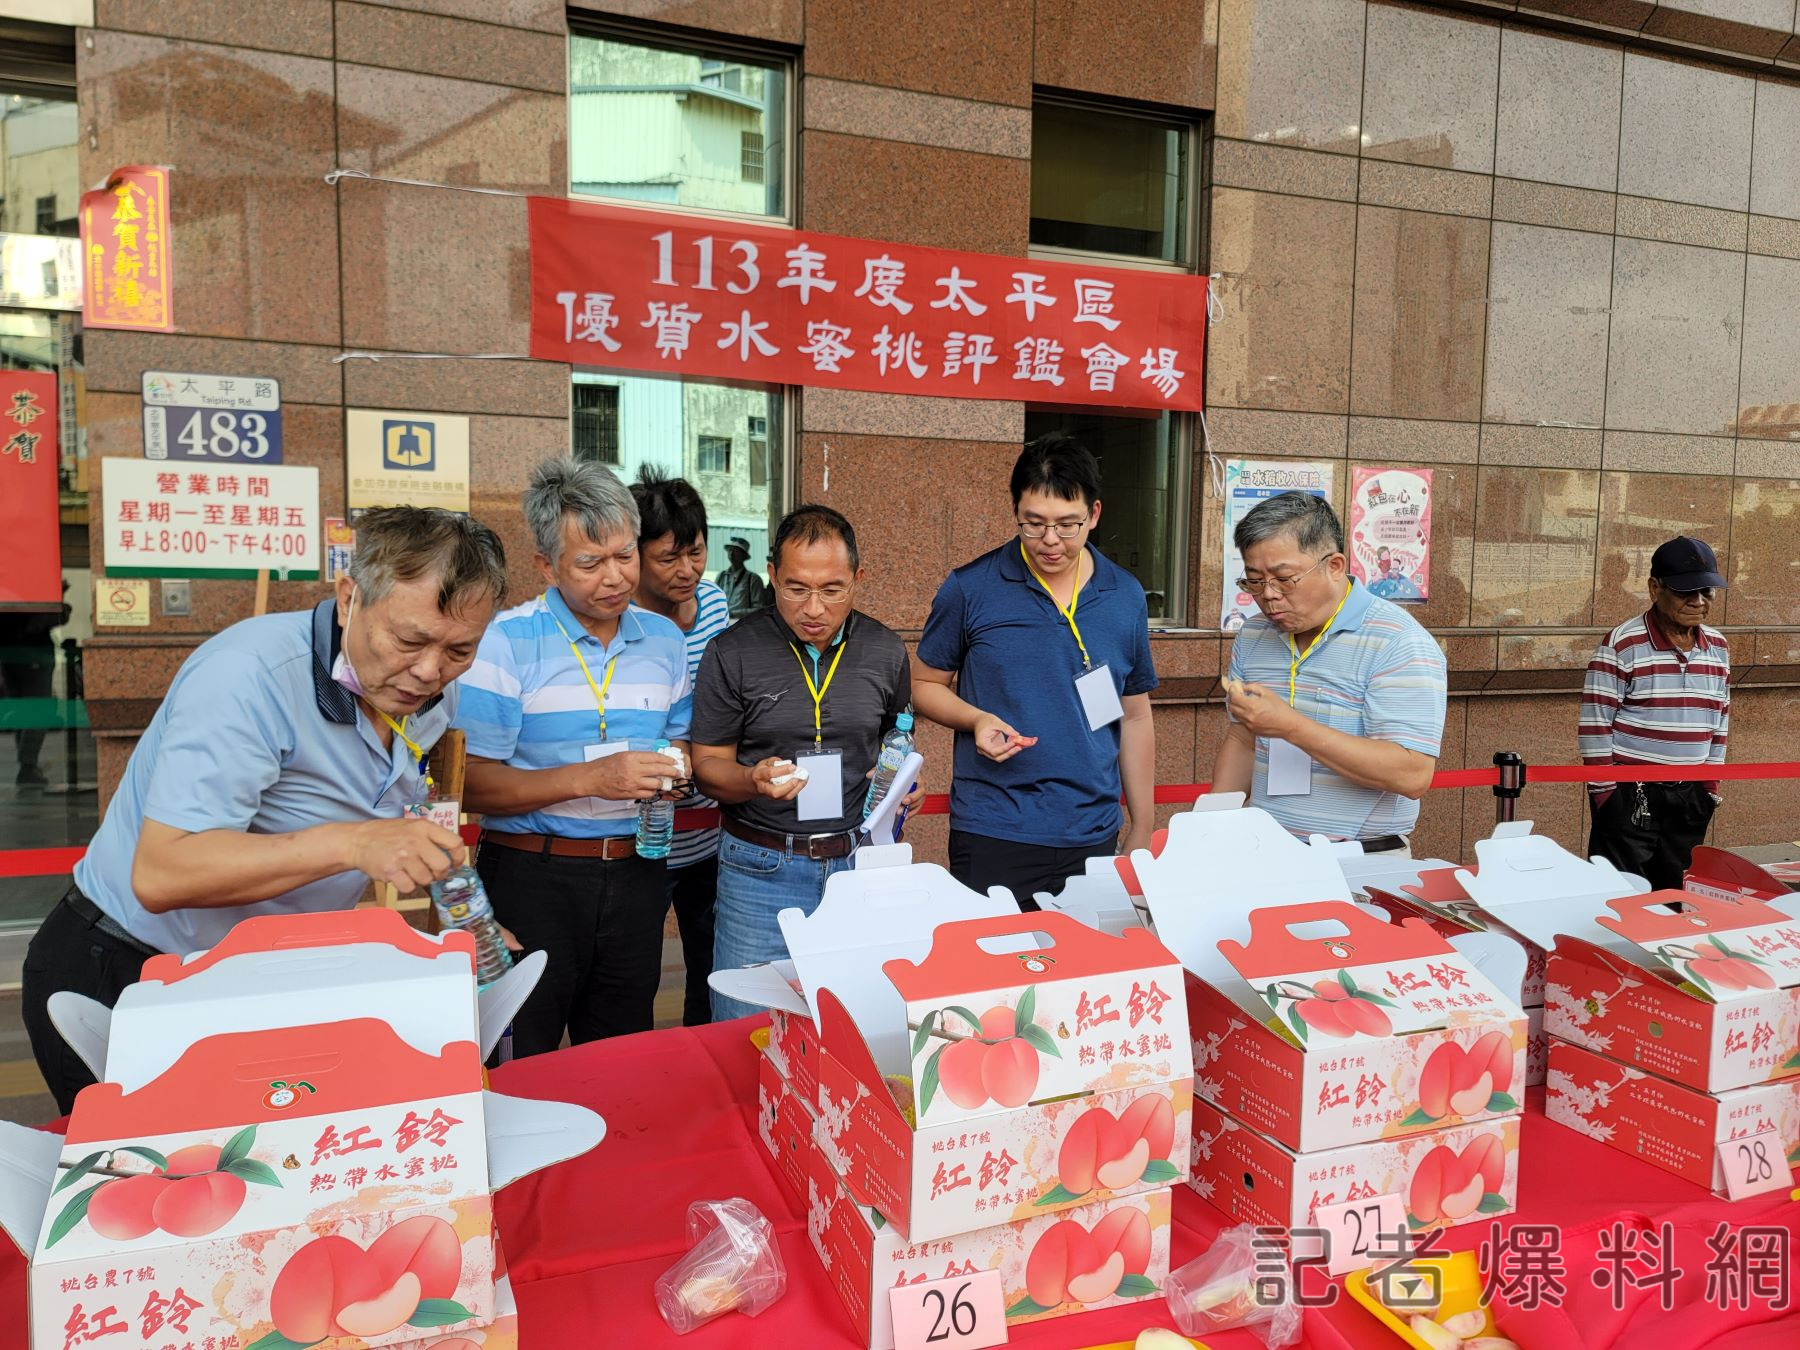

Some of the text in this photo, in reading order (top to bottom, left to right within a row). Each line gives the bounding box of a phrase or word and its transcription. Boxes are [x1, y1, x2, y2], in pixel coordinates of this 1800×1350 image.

[650, 231, 1122, 332] 113年度太平區
[555, 291, 1185, 399] 優質水蜜桃評鑑會場
[181, 378, 272, 398] 太平路
[202, 396, 236, 407] Taiping
[5, 389, 43, 463] 恭賀
[177, 409, 269, 459] 483
[156, 472, 270, 498] 營業時間
[1253, 469, 1320, 487] 水稻收入保險
[119, 500, 306, 528] 星期一至星期五
[119, 530, 306, 556] 早上8:00~下午4:00
[1386, 962, 1471, 995] 紅鈴
[1075, 980, 1172, 1038] 紅鈴
[1412, 991, 1493, 1013] 熱帶水蜜桃
[1079, 1034, 1172, 1068] 熱帶水蜜桃
[1724, 1021, 1775, 1058] 紅鈴
[1319, 1056, 1366, 1074] 桃台農7號
[1317, 1072, 1388, 1115] 紅鈴
[1351, 1109, 1403, 1129] 熱帶水蜜桃
[309, 1108, 464, 1167] 紅鈴
[931, 1130, 991, 1153] 桃台農7號
[309, 1154, 458, 1194] 熱帶水蜜桃
[930, 1150, 1020, 1201] 紅鈴
[1308, 1163, 1355, 1183] 桃台農7號
[1738, 1140, 1772, 1185] 28
[974, 1187, 1039, 1213] 熱帶水蜜桃
[1343, 1204, 1383, 1256] 27
[892, 1241, 953, 1262] 桃台農7號
[60, 1266, 156, 1293] 桃台農7號
[63, 1287, 205, 1350] 紅鈴
[922, 1282, 977, 1343] 26
